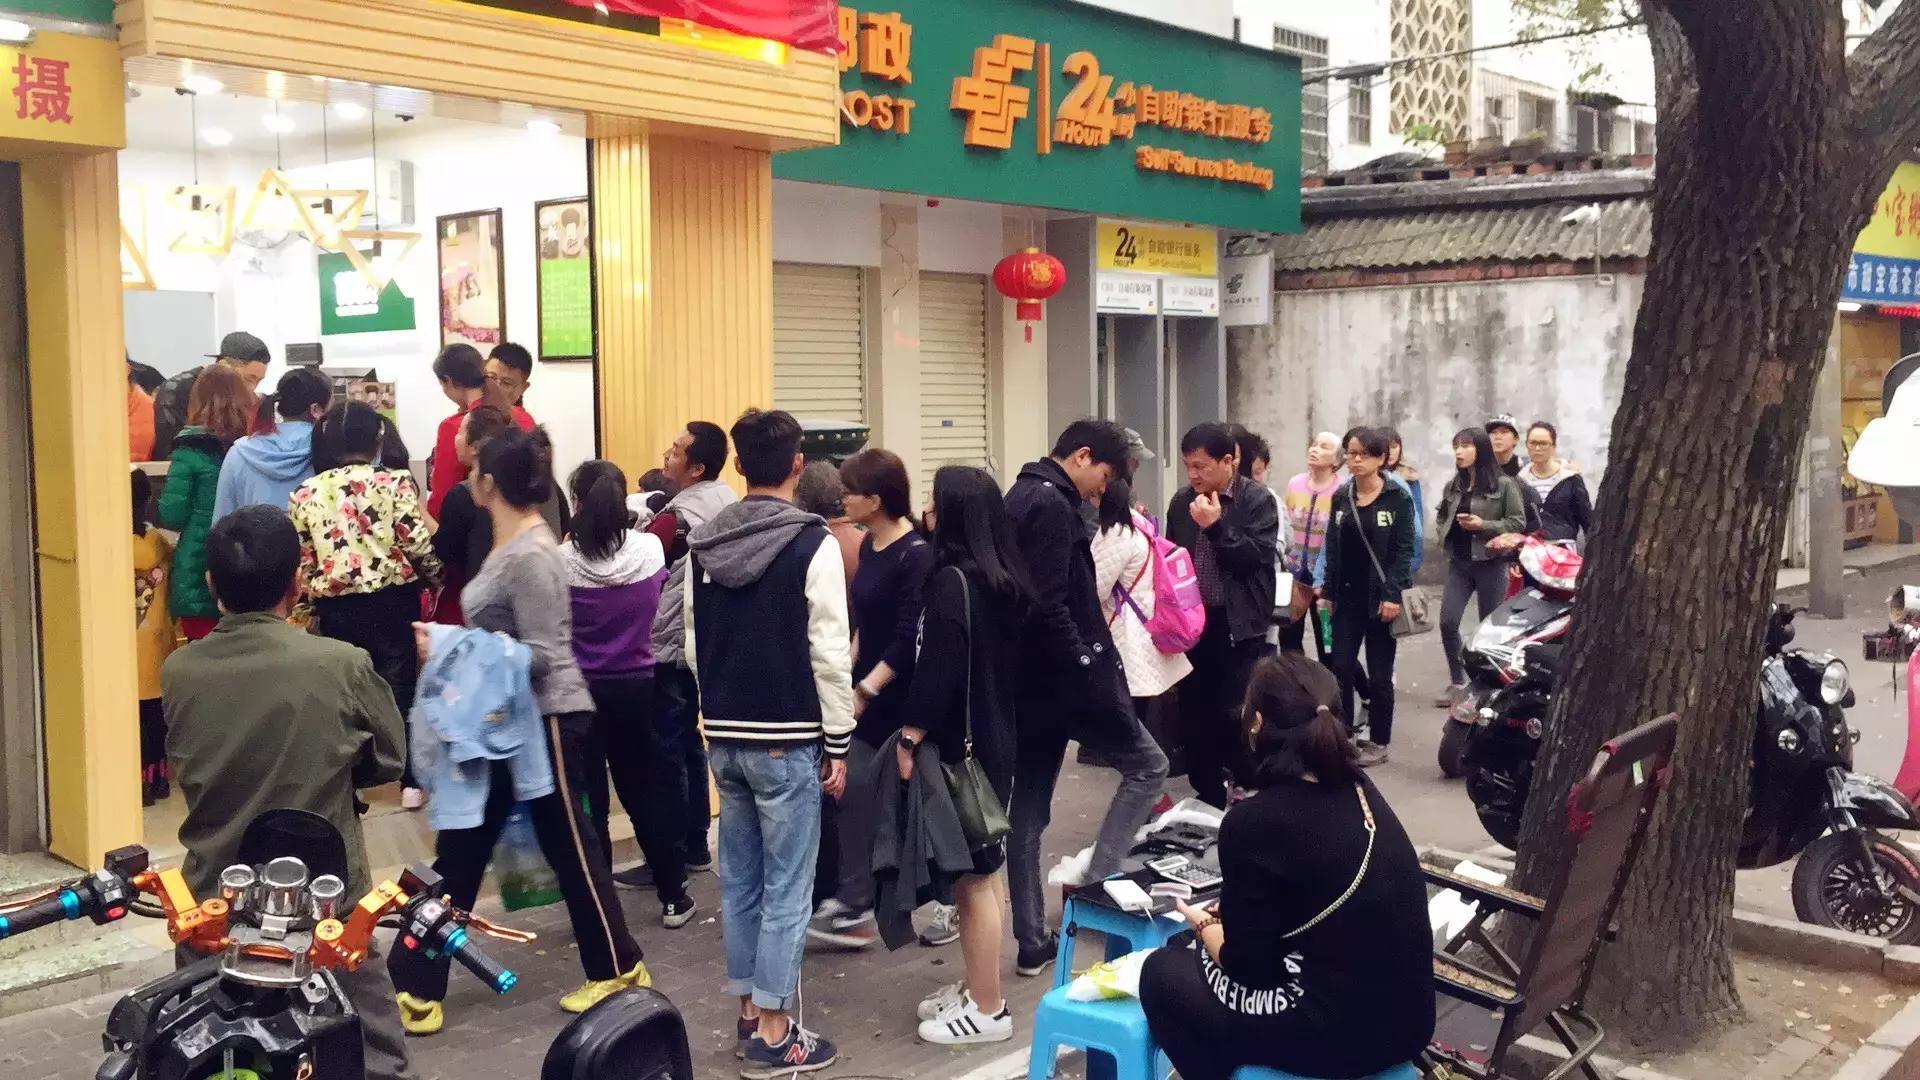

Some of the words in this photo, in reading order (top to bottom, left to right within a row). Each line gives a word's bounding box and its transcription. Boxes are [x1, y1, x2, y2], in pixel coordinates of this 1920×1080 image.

[11, 52, 73, 124] 摄
[841, 89, 916, 135] OST
[1115, 227, 1137, 265] 24
[783, 1043, 811, 1065] N
